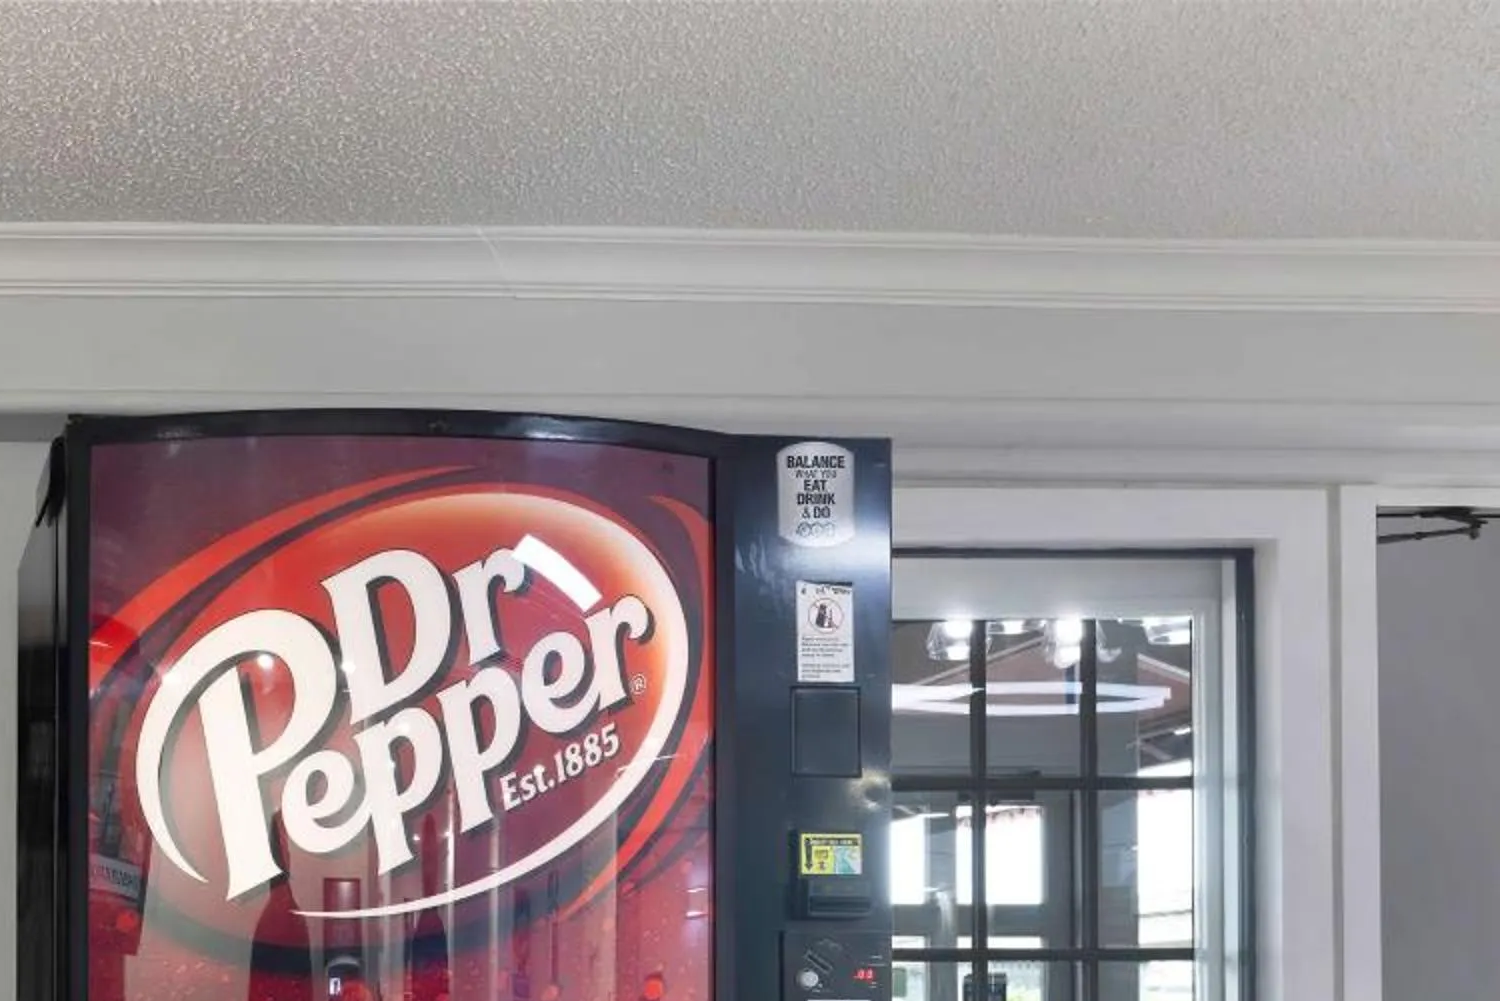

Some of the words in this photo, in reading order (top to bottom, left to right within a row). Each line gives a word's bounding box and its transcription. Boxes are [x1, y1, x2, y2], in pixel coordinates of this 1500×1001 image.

[786, 455, 845, 469] BALANCE
[803, 479, 828, 492] EAT
[797, 493, 836, 505] DRINK
[813, 506, 831, 519] DO
[321, 546, 531, 725] Dr
[136, 596, 651, 901] Pepper
